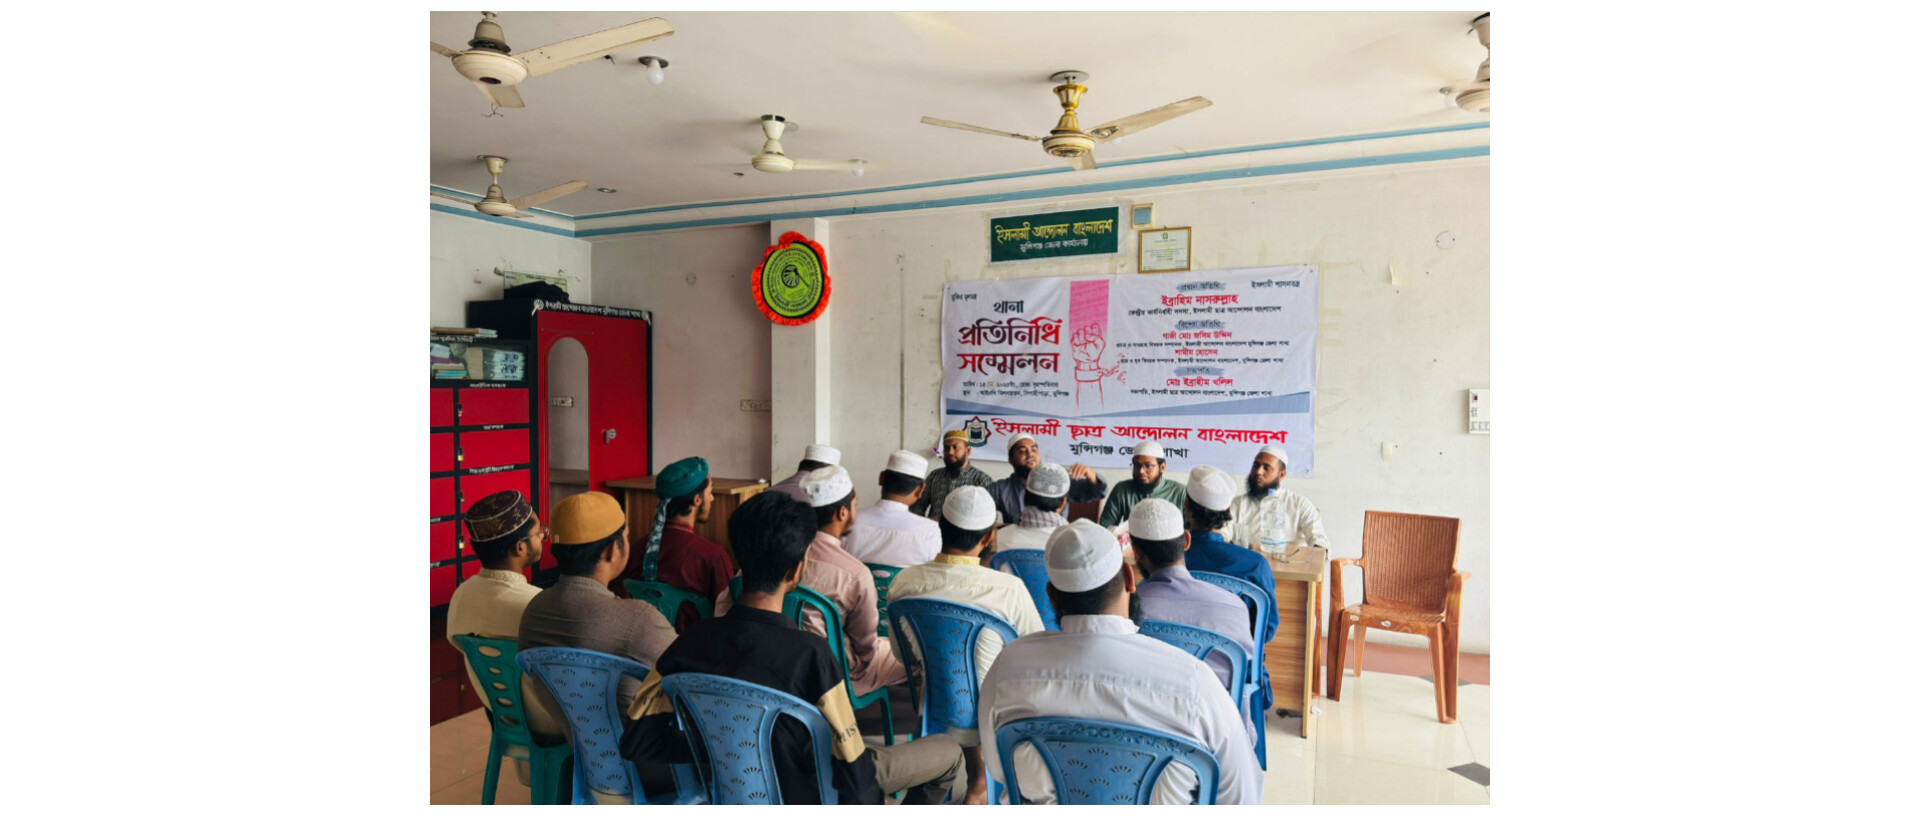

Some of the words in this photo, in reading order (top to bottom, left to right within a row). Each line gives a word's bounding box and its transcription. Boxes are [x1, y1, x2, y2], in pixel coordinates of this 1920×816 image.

[994, 222, 1030, 244] ইসলামী
[1032, 224, 1070, 239] আন্দোলন
[1073, 219, 1113, 236] বাংলাদেশ
[1251, 280, 1272, 288] ইসলামী
[993, 300, 1024, 313] থানা
[1162, 294, 1192, 307] ইব্রাহিম
[1196, 294, 1239, 305] নাসরুল্লাহ
[1193, 306, 1212, 314] ইসলামী
[958, 316, 1062, 346] প্রতিনিধি
[957, 353, 1060, 376] সম্মেলন
[991, 418, 1060, 437] ইসলামী
[1066, 425, 1106, 441] ছাত্র
[1110, 426, 1193, 441] আন্দোলন
[1198, 428, 1288, 444] বাংলাদেশ
[1069, 442, 1114, 456] মুন্সিগঞ্জ
